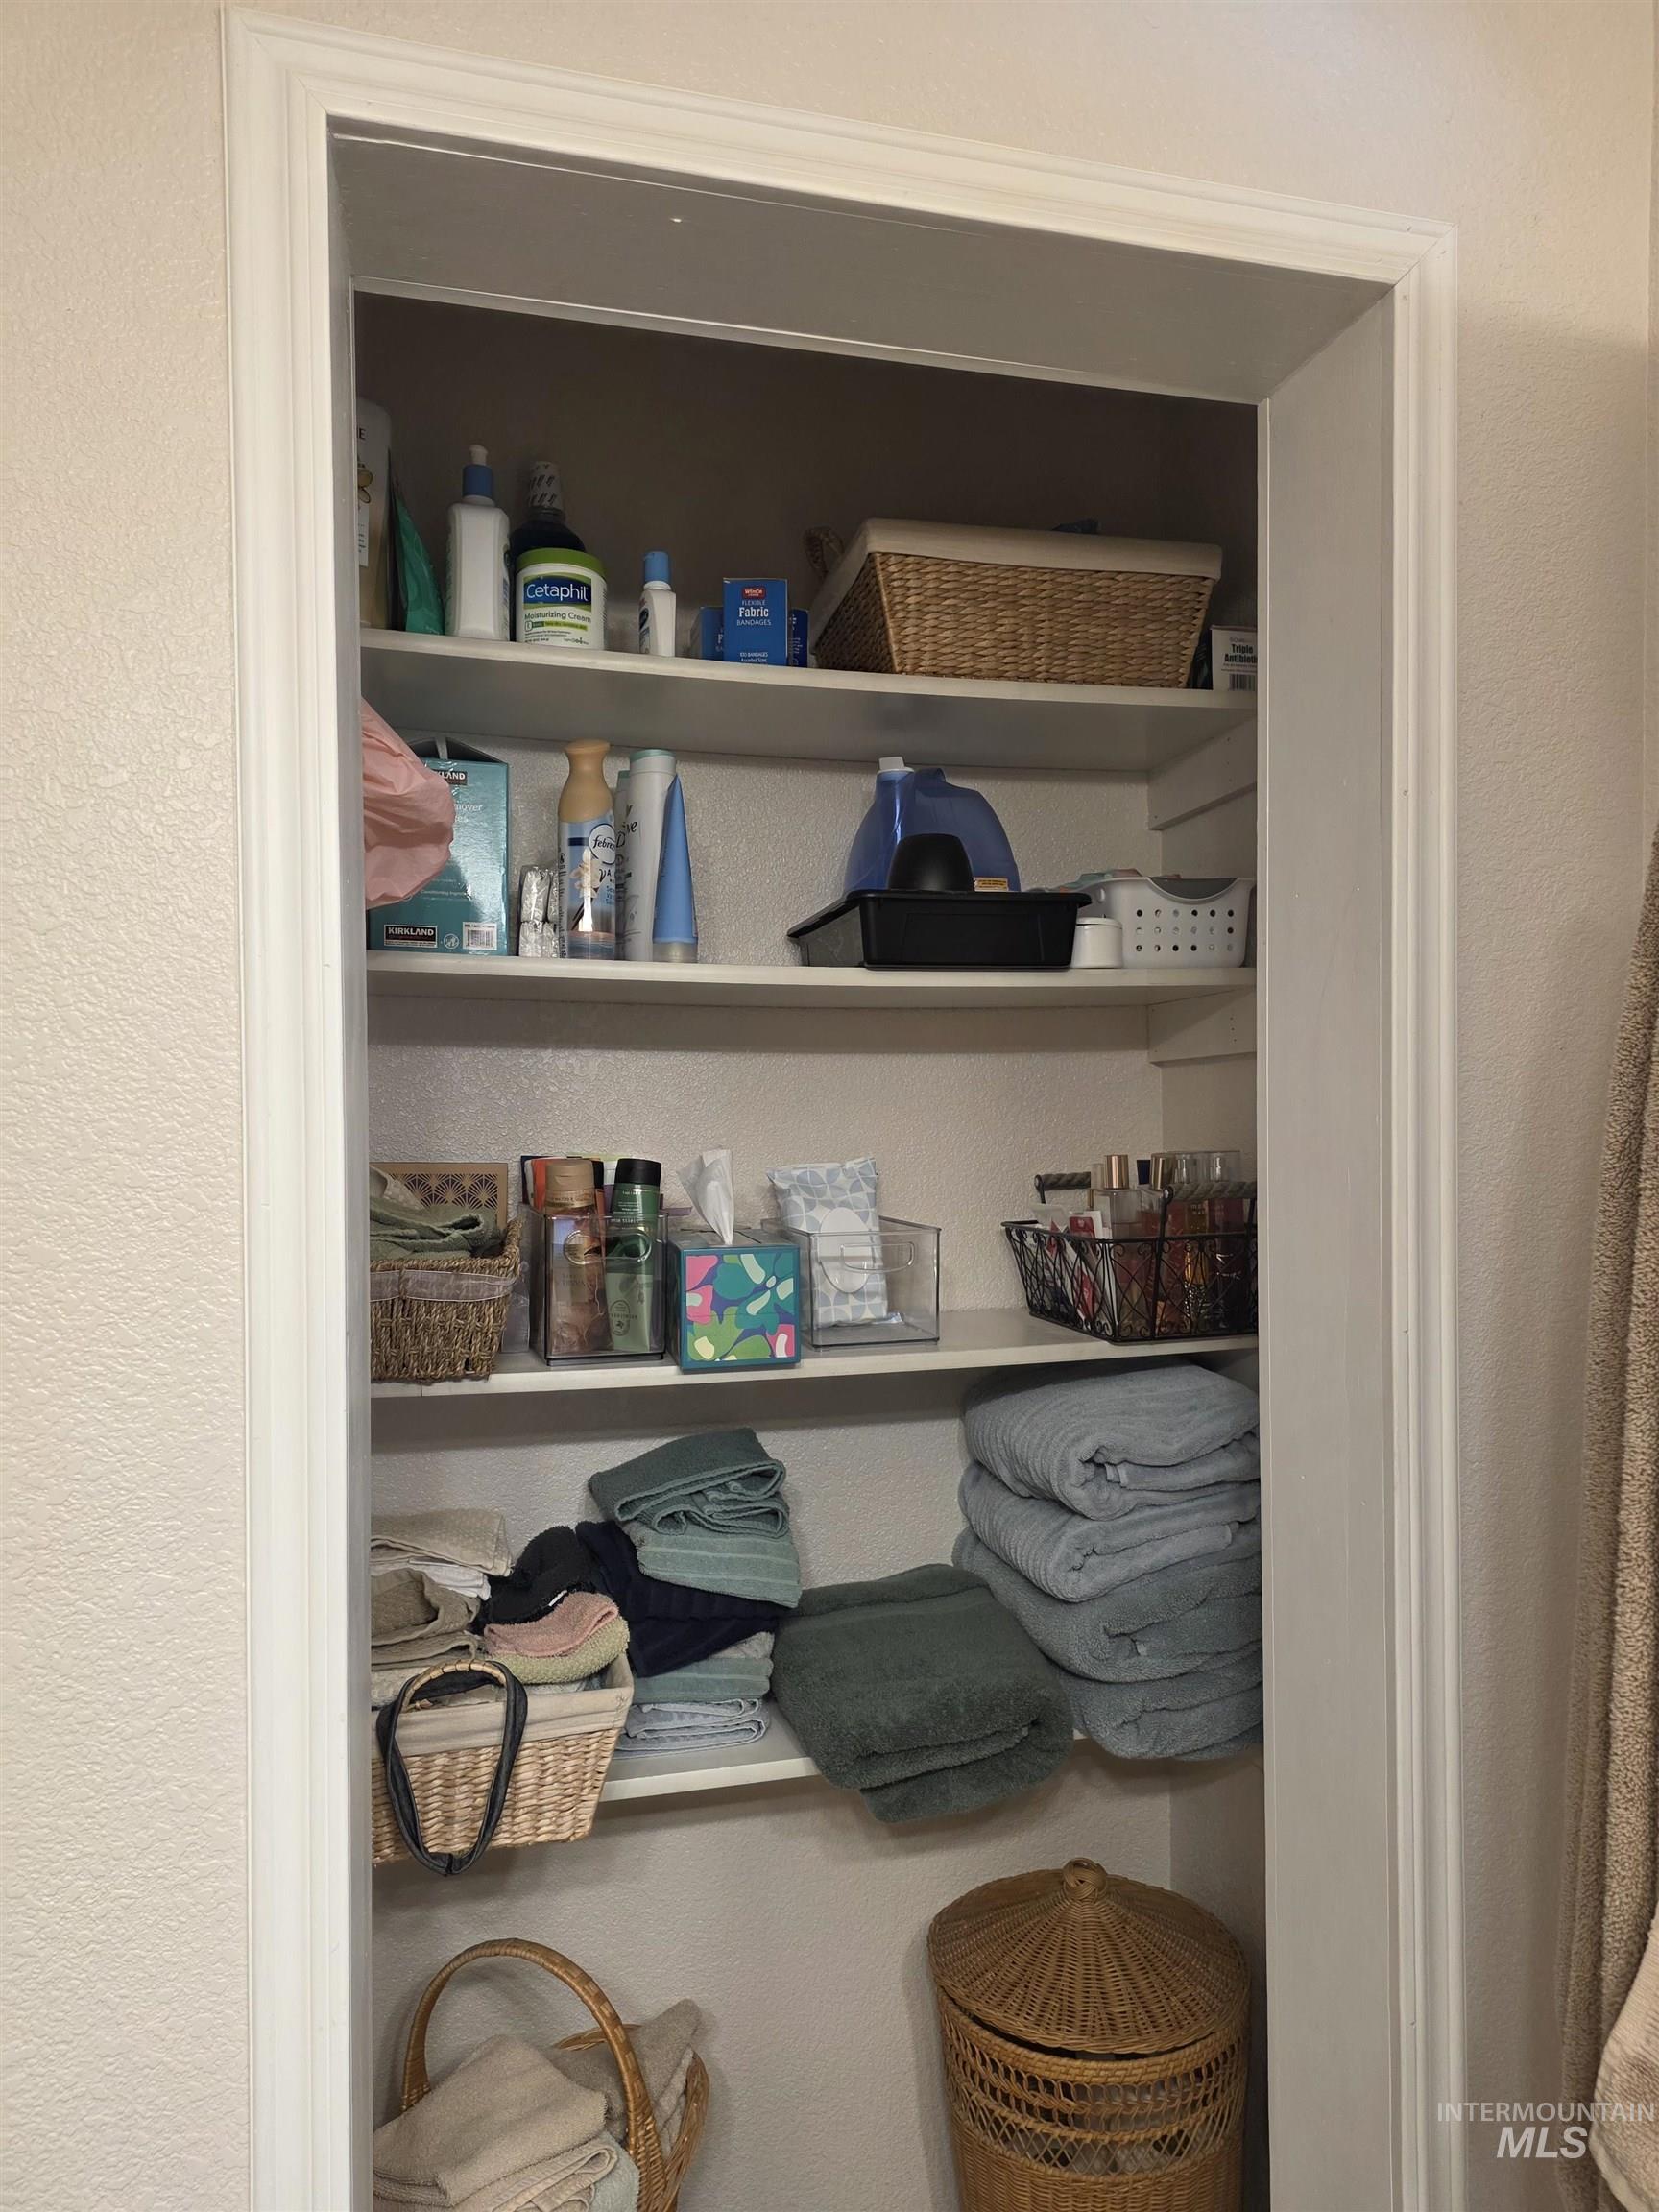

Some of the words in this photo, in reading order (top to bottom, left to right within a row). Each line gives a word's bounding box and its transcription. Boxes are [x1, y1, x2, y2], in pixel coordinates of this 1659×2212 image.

[526, 583, 589, 602] Cetaphil
[524, 612, 566, 620] Moisturizing
[568, 612, 592, 623] Cream
[738, 607, 769, 617] Fabric
[1231, 643, 1254, 654] Triple
[1224, 653, 1258, 664] Antibioti
[388, 926, 435, 936] KIRKLAND
